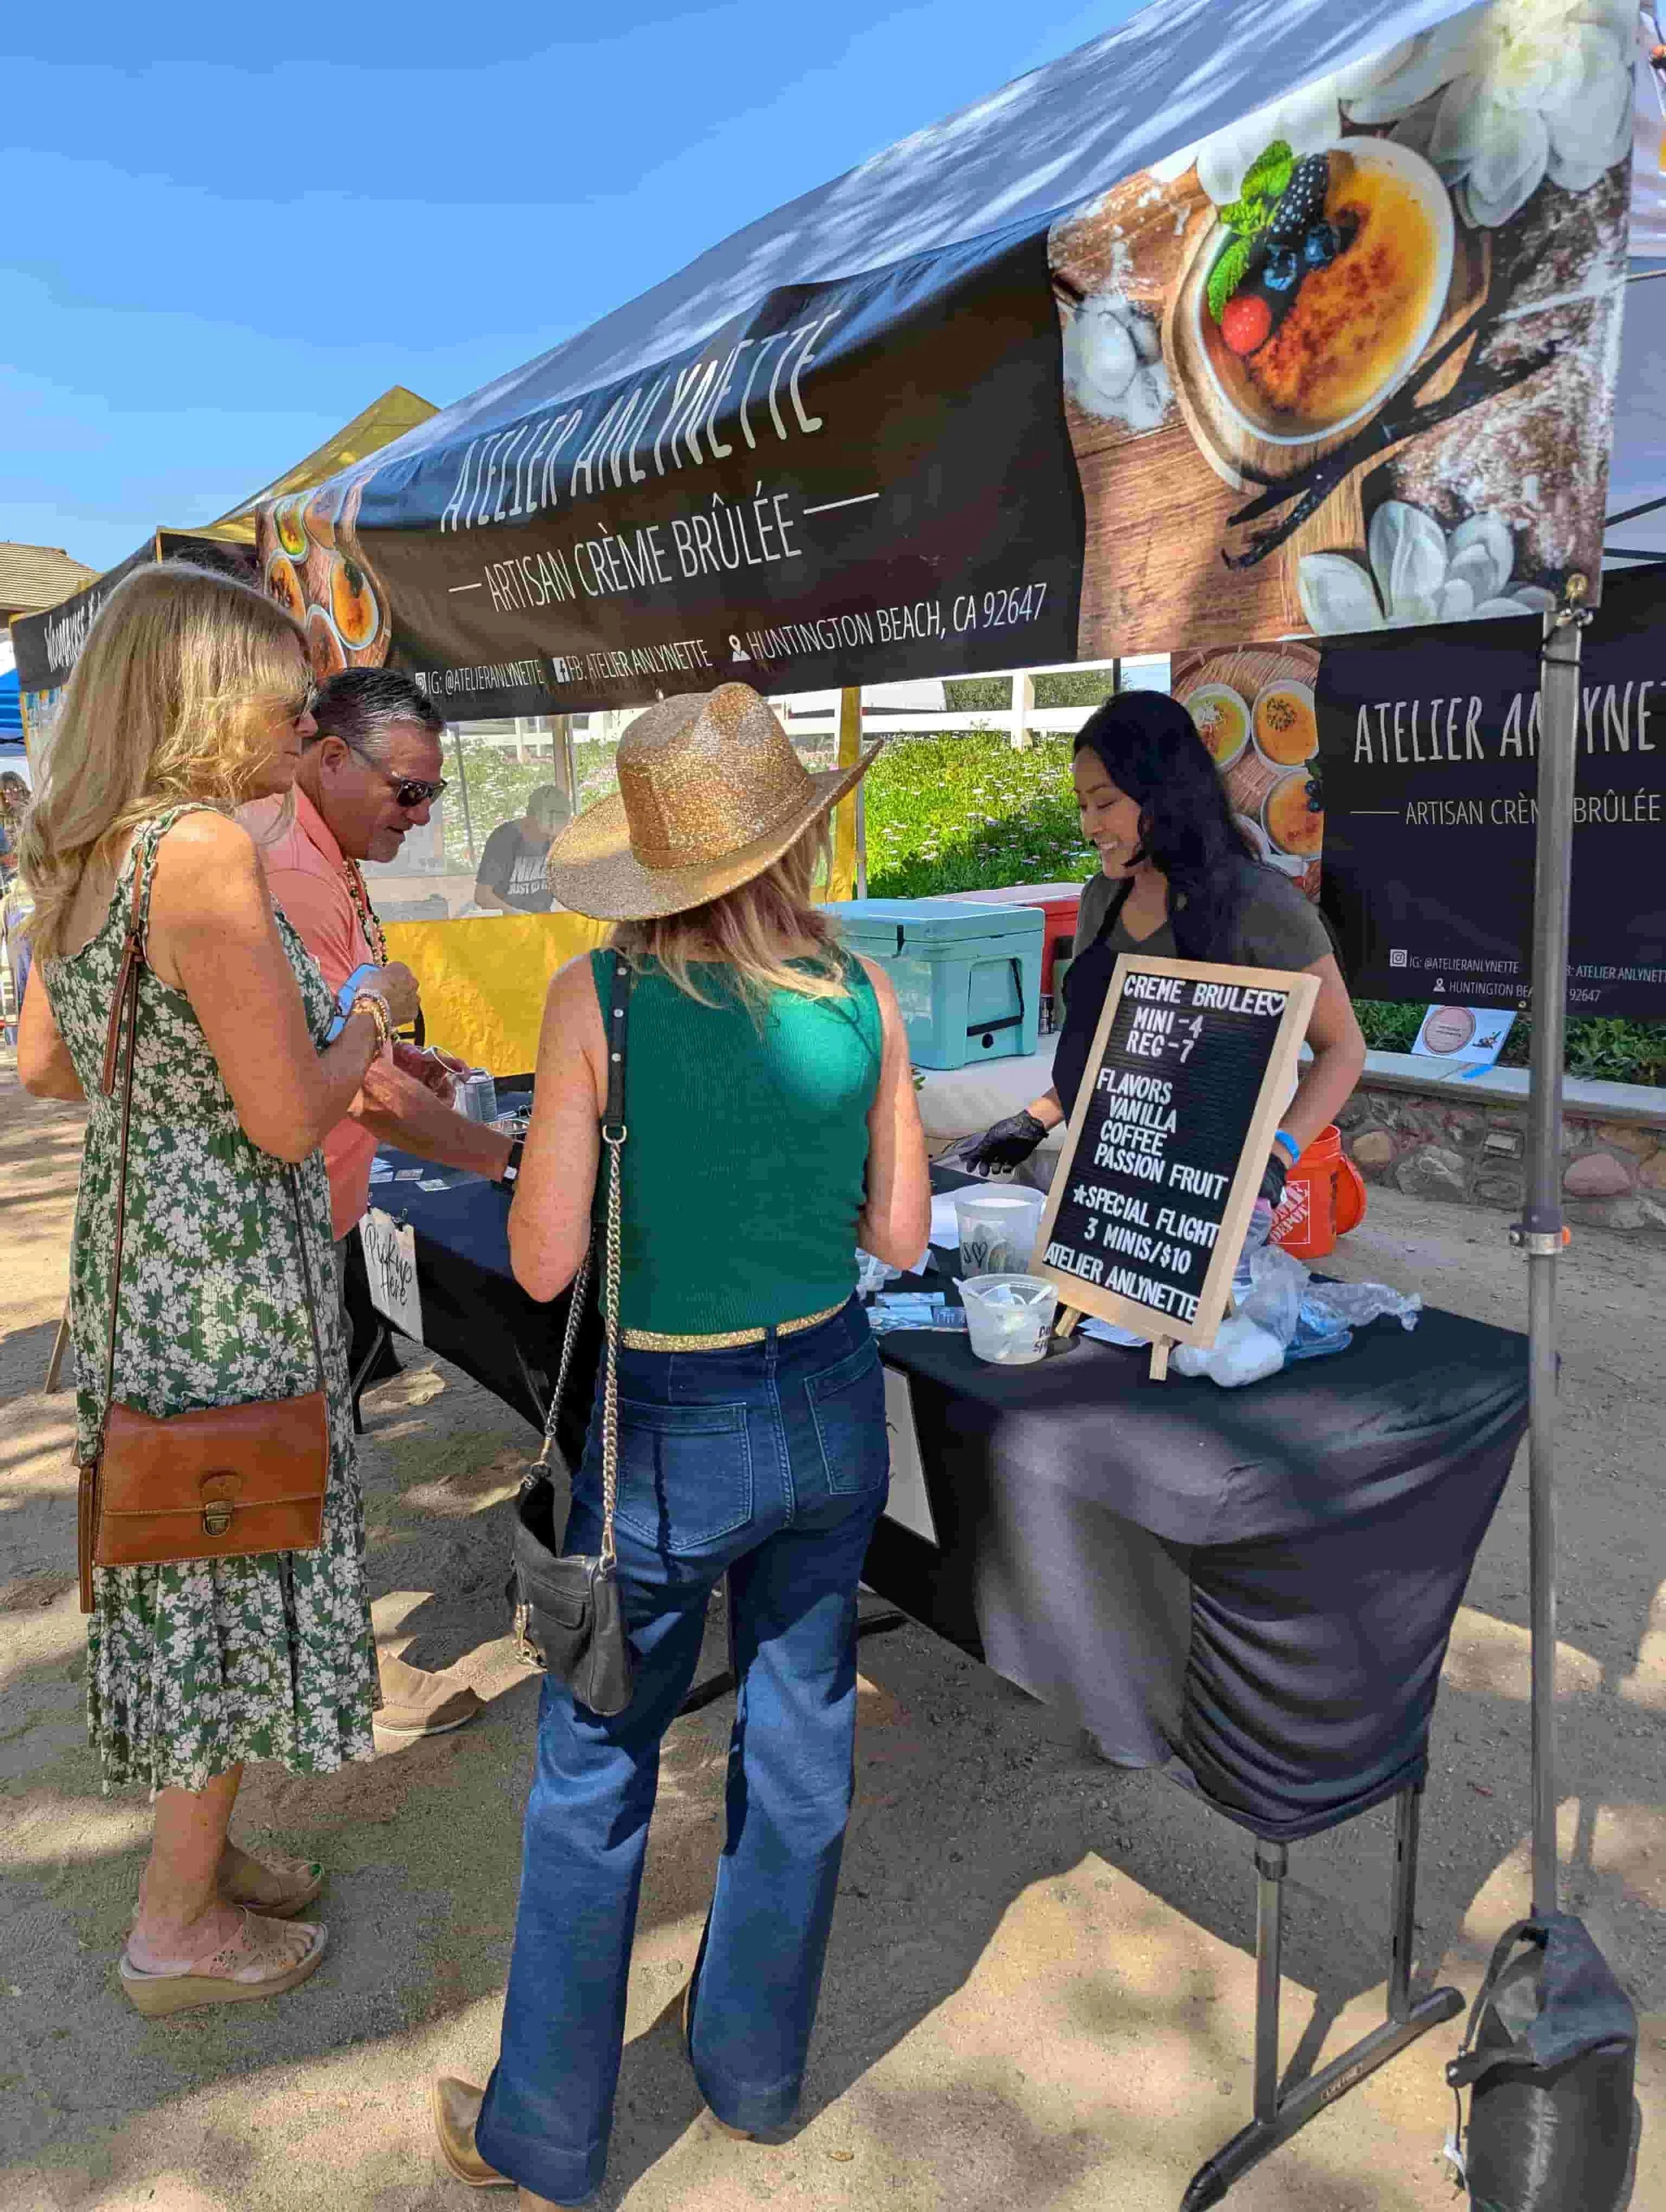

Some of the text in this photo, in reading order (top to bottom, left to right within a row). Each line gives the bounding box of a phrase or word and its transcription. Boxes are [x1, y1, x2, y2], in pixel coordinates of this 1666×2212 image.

[440, 408, 583, 532] ATELIER
[484, 480, 802, 612] ARTISAN CRÈME BRÛLÉE
[746, 583, 1048, 660] HUNTINGTON BEACH, CA 92647
[428, 660, 544, 695] IG: @ATELIERANLYNETTE
[586, 651, 634, 680] ATELIER
[631, 639, 713, 676] ANLYNETTE
[1354, 696, 1484, 764] ATELIER
[1406, 801, 1483, 825] ARTISAN
[1573, 788, 1661, 824] BRÛLÉE
[1449, 980, 1514, 996] HUNTINGTON
[1569, 987, 1601, 1003] 92647
[1575, 965, 1616, 979] ATELIER
[1617, 967, 1666, 983] ANLYNETT
[1124, 975, 1269, 1016] CREME BRULEE
[1133, 1006, 1175, 1034] MINI
[1097, 1067, 1173, 1105] FLAVORS
[1109, 1095, 1177, 1133] VANILLA
[1100, 1120, 1168, 1157] COFFEE
[1094, 1143, 1229, 1201] PASSION FRUIT
[1084, 1217, 1099, 1241] 3
[1156, 1208, 1221, 1249] FLIGHT
[1043, 1242, 1104, 1284] ATELIER
[1104, 1266, 1200, 1321] ANLYNETTE
